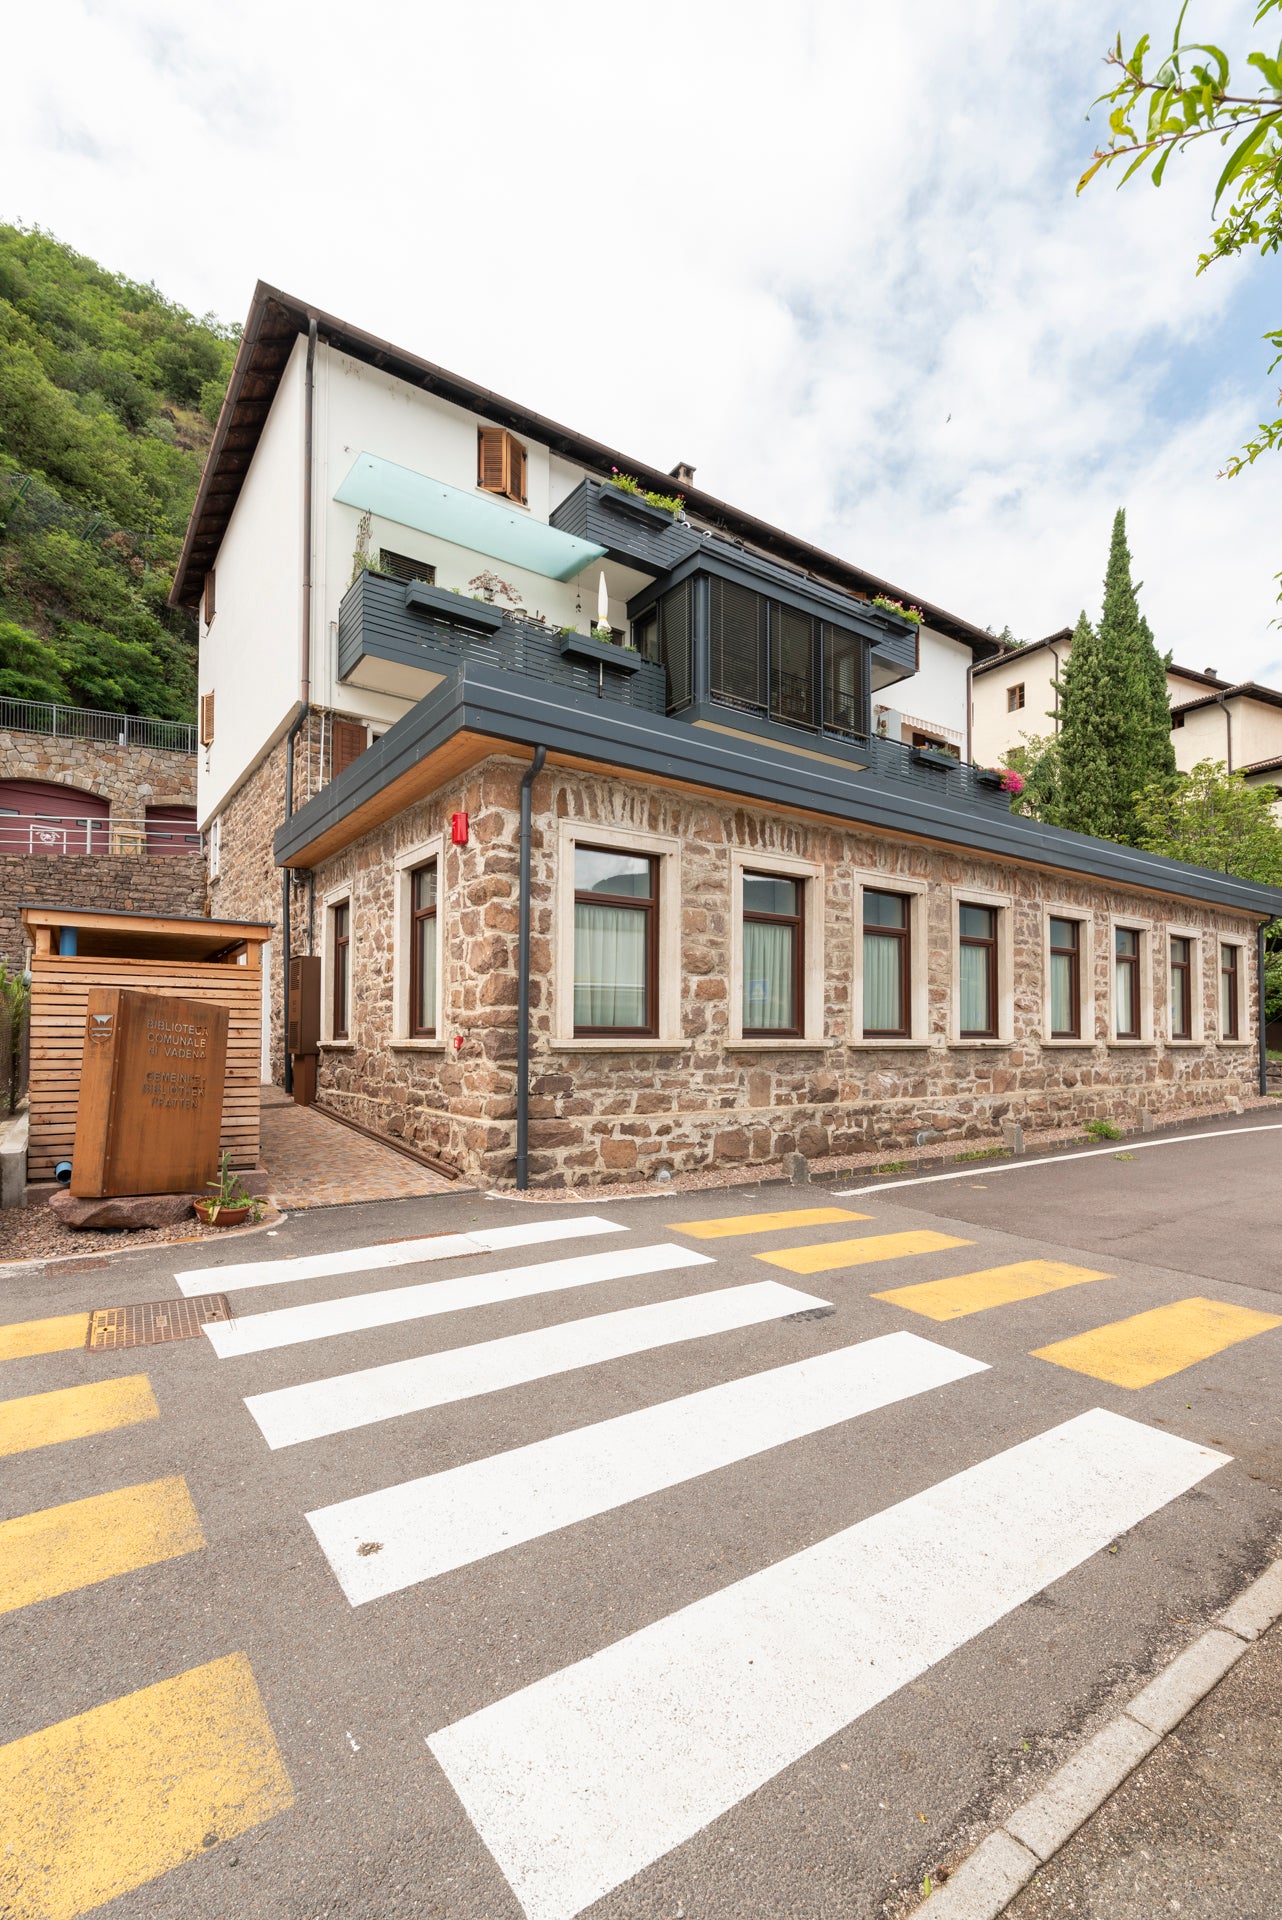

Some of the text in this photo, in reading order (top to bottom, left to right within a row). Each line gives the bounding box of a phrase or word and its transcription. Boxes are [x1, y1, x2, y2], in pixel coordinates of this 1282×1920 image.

[147, 1020, 209, 1036] BIBLIOTECA
[148, 1033, 206, 1047] COMUNALE
[165, 1047, 206, 1059] VADENA
[142, 1082, 205, 1096] BIBLIOTHEK
[152, 1096, 198, 1109] PFATTEN
